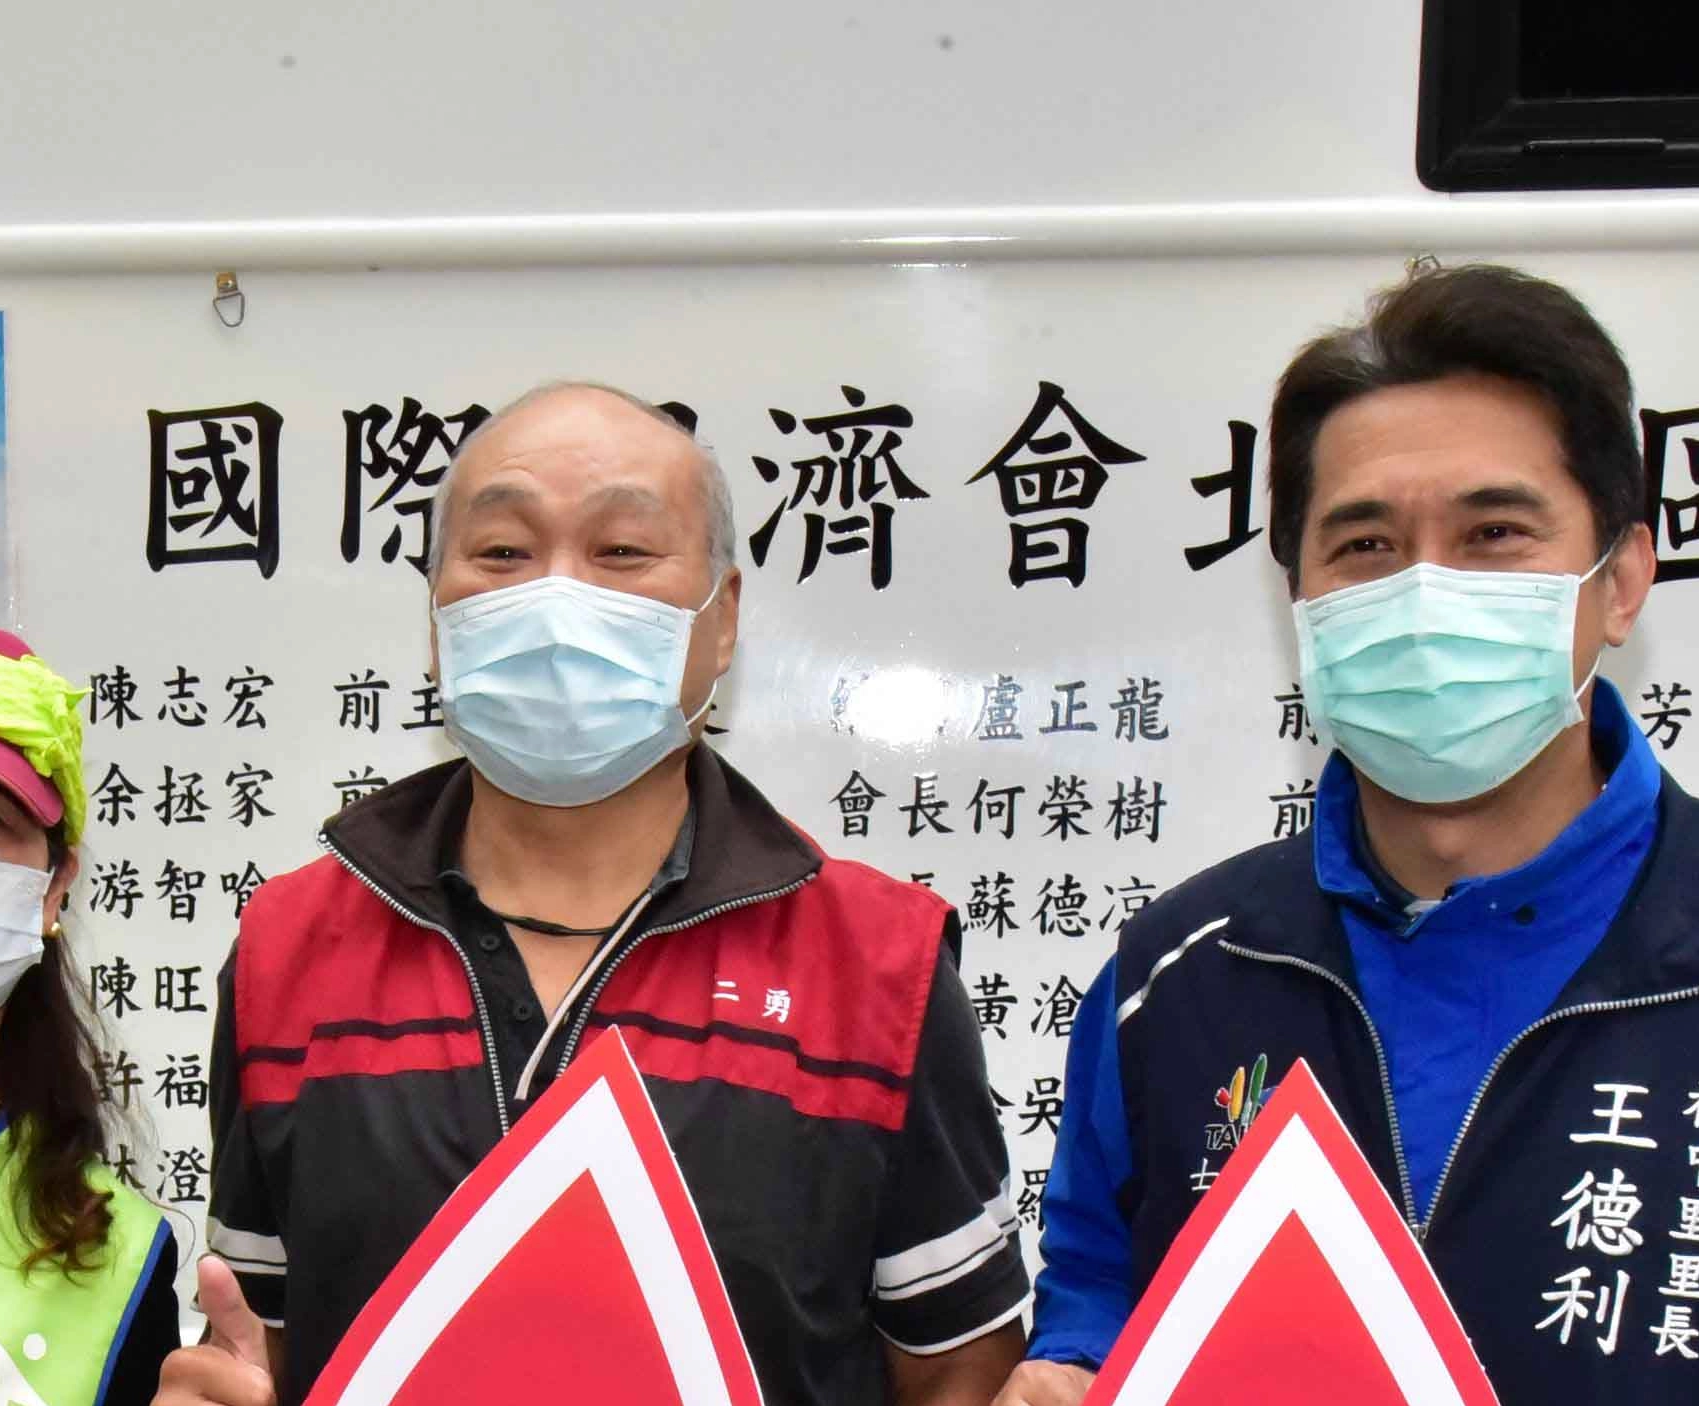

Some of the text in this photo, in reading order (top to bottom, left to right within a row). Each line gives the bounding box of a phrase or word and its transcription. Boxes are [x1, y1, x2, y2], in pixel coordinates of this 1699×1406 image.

[89, 665, 275, 730] 陳志宏
[91, 762, 277, 828] 余拯家
[829, 770, 1168, 844] 會長何榮樹
[712, 977, 793, 1025] 二勇
[1204, 1123, 1249, 1151] TA
[1534, 1082, 1659, 1357] 王德利
